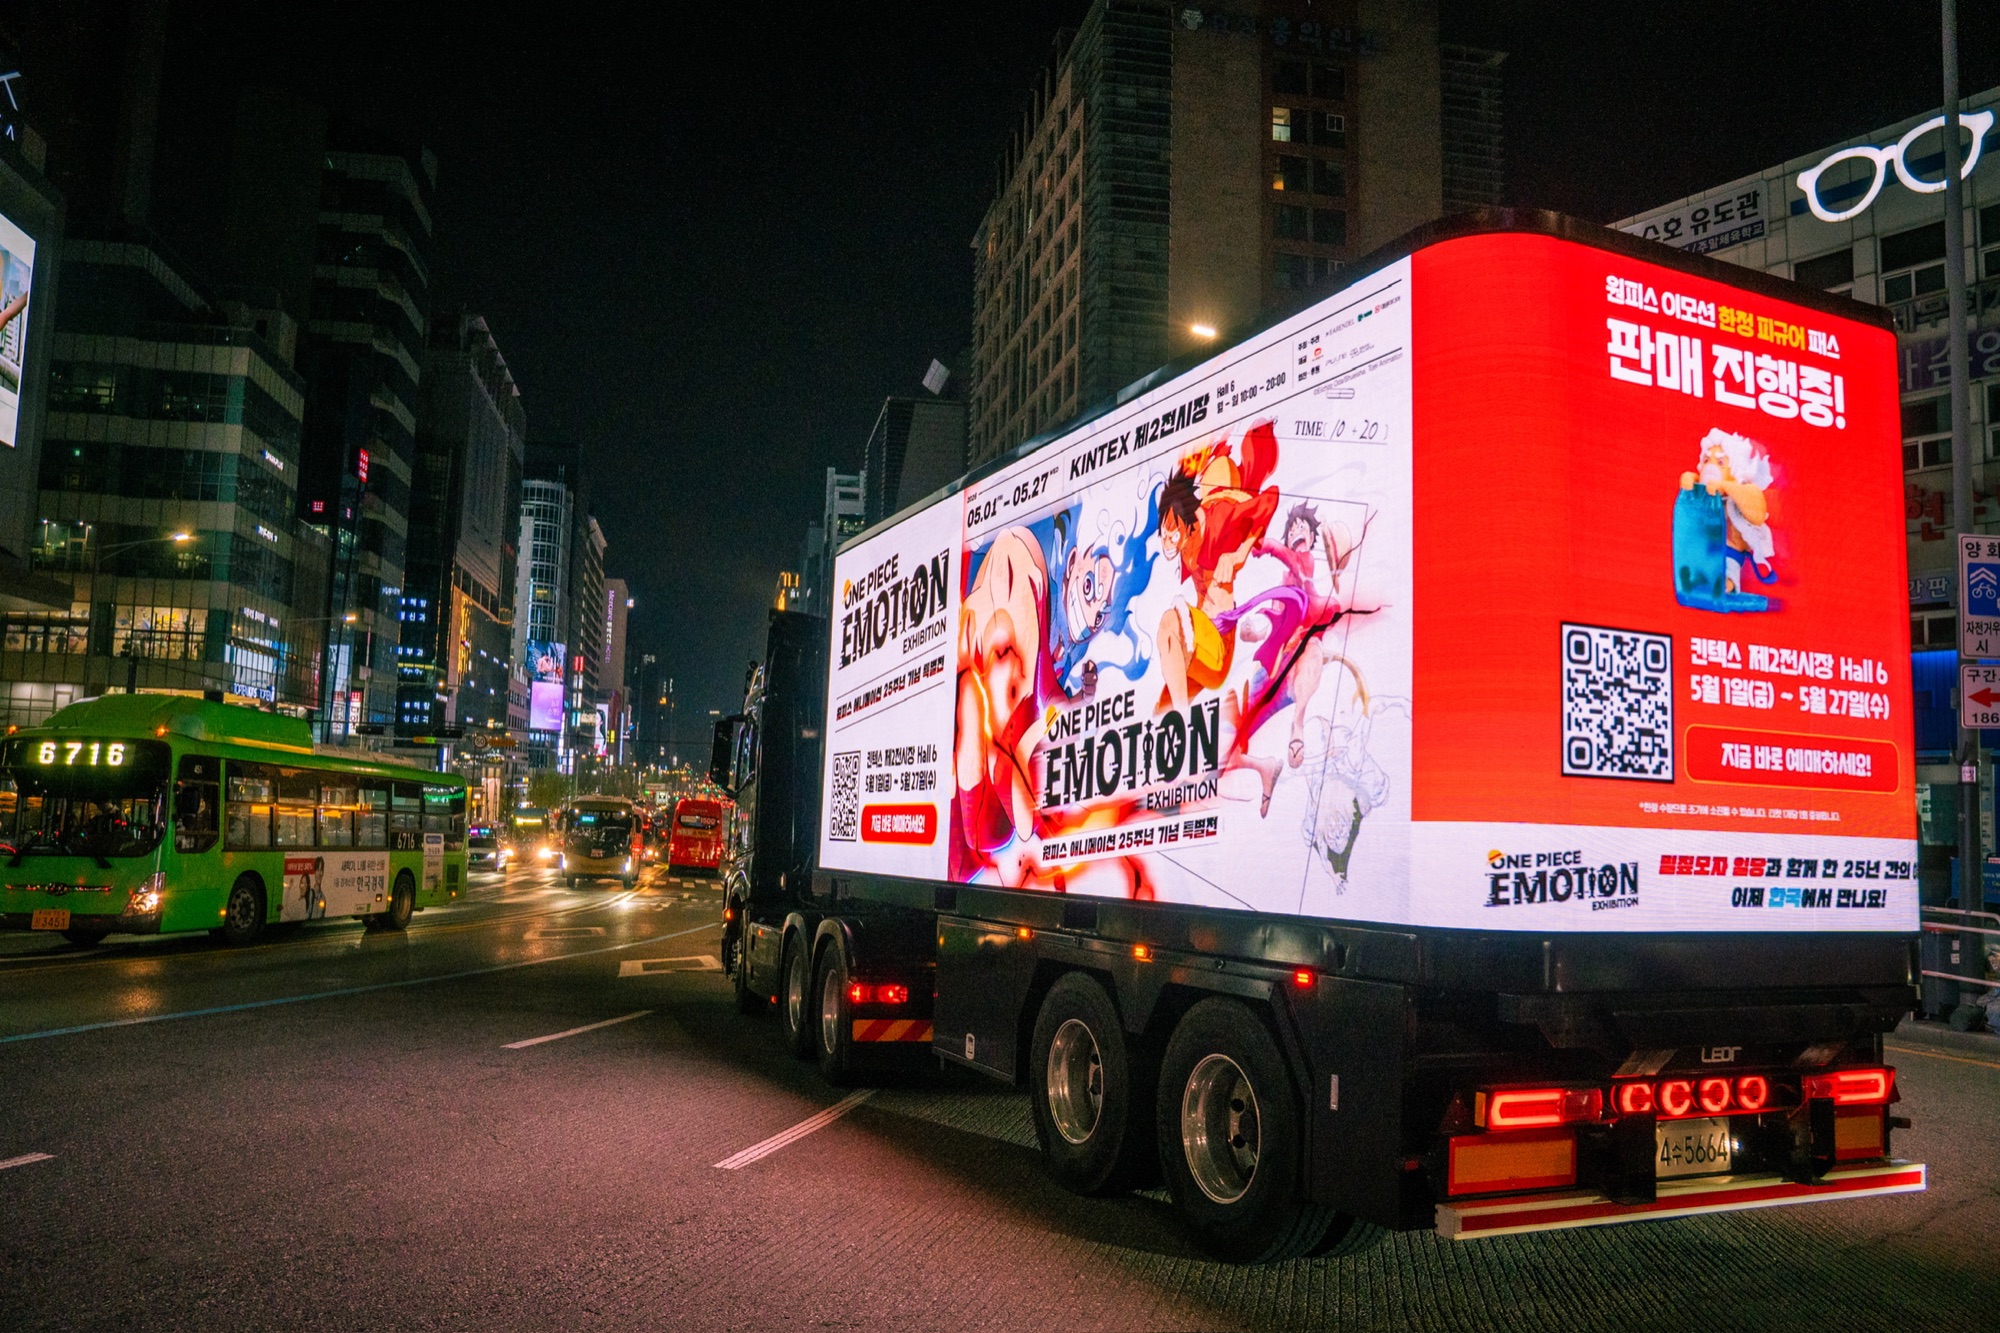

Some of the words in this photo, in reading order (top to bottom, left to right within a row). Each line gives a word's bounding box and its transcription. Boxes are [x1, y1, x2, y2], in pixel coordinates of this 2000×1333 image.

[1690, 190, 1760, 236] 유도관
[1605, 274, 1659, 313] 원피스
[1661, 291, 1716, 328] 이모션
[1718, 305, 1754, 338] 한정
[1756, 315, 1806, 351] 피규어
[1807, 328, 1841, 359] 패스
[1216, 382, 1229, 398] Hall
[1230, 380, 1235, 391] 6
[1265, 372, 1286, 391] 20:00
[1606, 317, 1704, 399] 판매
[1711, 344, 1847, 430] 진행중!
[1069, 431, 1131, 481] KINTEX
[1132, 393, 1210, 452] 제2전시장
[967, 497, 997, 528] 05.01
[1012, 471, 1049, 506] 05.27
[843, 577, 866, 610] ONE
[866, 553, 899, 596] PIECE
[838, 548, 950, 672] EMOTION
[902, 616, 947, 656] EXHIBITION
[1690, 637, 1742, 670] 킨텍스
[1748, 643, 1834, 680] 제2전시장
[1839, 656, 1874, 684] Hall
[1876, 661, 1888, 685] 6
[1967, 669, 2000, 683] 구간
[883, 674, 905, 698] 25주년
[907, 666, 921, 688] 기념
[1690, 674, 1720, 705] 5월
[1722, 678, 1775, 710] 1일(금)
[1799, 686, 1827, 715] 5월
[1829, 689, 1890, 720] 27일(수)
[1047, 709, 1082, 742] ONE
[1085, 689, 1135, 731] PIECE
[38, 741, 125, 766] 6716
[866, 749, 883, 769] 킨텍스
[884, 746, 916, 767] 제2전시장
[917, 744, 931, 764] Hall
[931, 744, 938, 763] 6
[1040, 697, 1220, 810] EMOTION
[1721, 742, 1751, 770] 지금
[1754, 745, 1783, 771] 바로
[1785, 748, 1872, 778] 예매하세요!
[865, 774, 874, 793] 5월
[900, 771, 911, 792] 5월
[911, 769, 937, 791] 27일(수)
[1147, 778, 1218, 811] EXHIBITION
[397, 832, 415, 850] 6716
[1042, 842, 1067, 861] 원피스
[1069, 834, 1116, 857] 애니메이션
[1118, 827, 1155, 850] 25주년
[1158, 822, 1180, 844] 기념
[1182, 815, 1218, 839] 특별전
[1490, 853, 1532, 870] ONE
[1536, 850, 1582, 867] PIECE
[1822, 858, 1838, 879] 한
[1843, 859, 1880, 879] 25년
[1884, 861, 1910, 880] 간의
[356, 875, 385, 892] 한국경제
[1483, 862, 1638, 907] EMOTION
[1768, 886, 1832, 908] 한국에서
[1836, 889, 1887, 908] 만나요!
[1592, 897, 1639, 911] EXHIBITION
[1658, 1132, 1728, 1167] 4수5664
